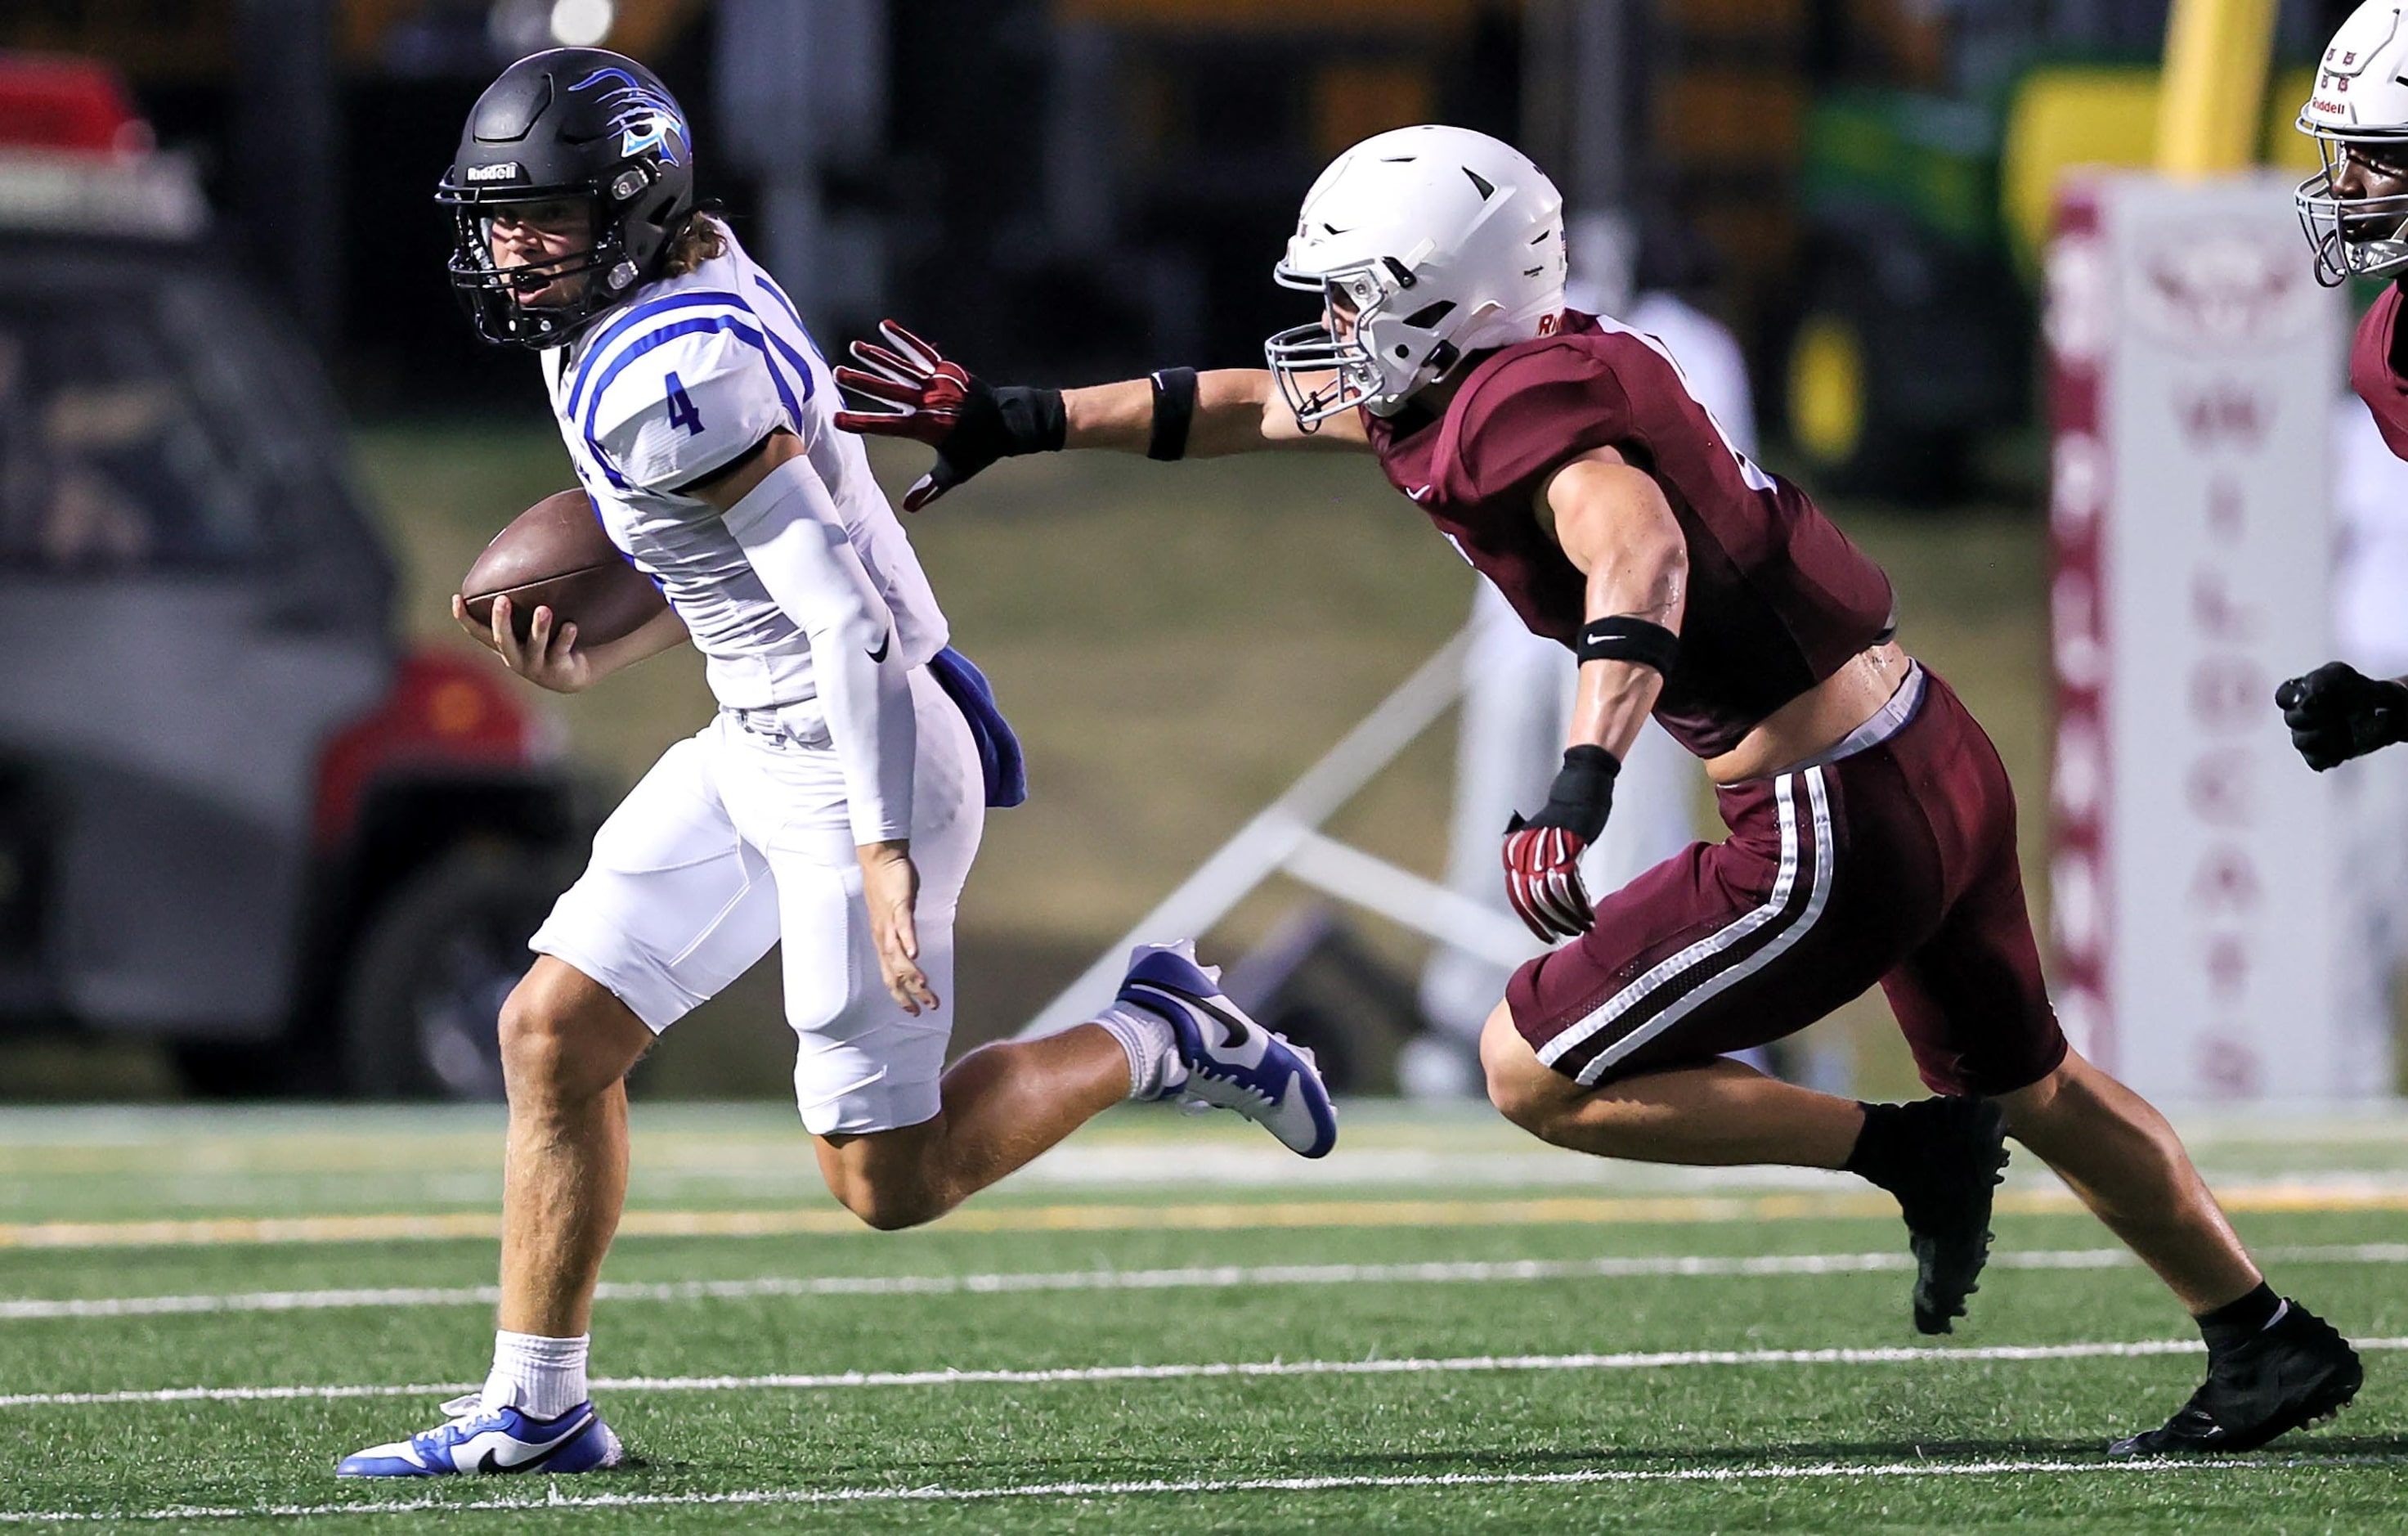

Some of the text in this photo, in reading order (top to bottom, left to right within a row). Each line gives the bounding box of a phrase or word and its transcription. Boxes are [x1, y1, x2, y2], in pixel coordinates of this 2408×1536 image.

[467, 163, 516, 180] Riddell
[666, 371, 705, 436] 4
[2171, 383, 2276, 1099] WILDCATS
